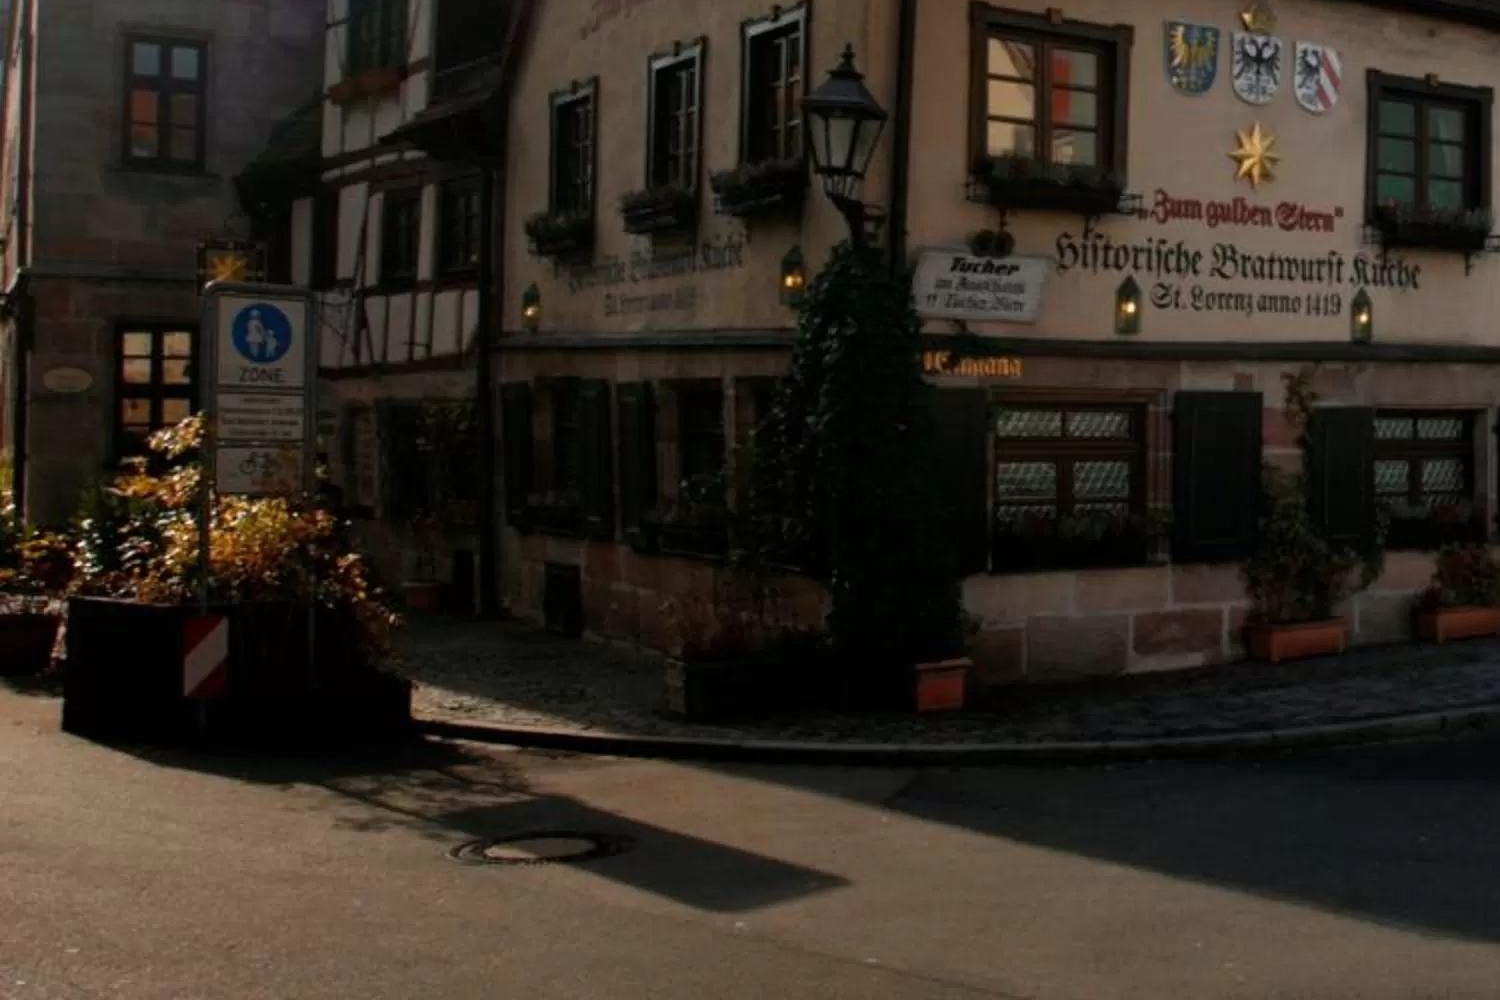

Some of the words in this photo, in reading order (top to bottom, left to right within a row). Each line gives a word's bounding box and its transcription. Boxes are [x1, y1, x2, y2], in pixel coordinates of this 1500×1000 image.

[950, 256, 1020, 276] Tucher
[1208, 242, 1345, 286] Bratwurst
[1190, 285, 1254, 317] Lorenz
[1256, 292, 1302, 315] anno
[1305, 292, 1342, 317] 1419
[239, 366, 287, 383] ZONE
